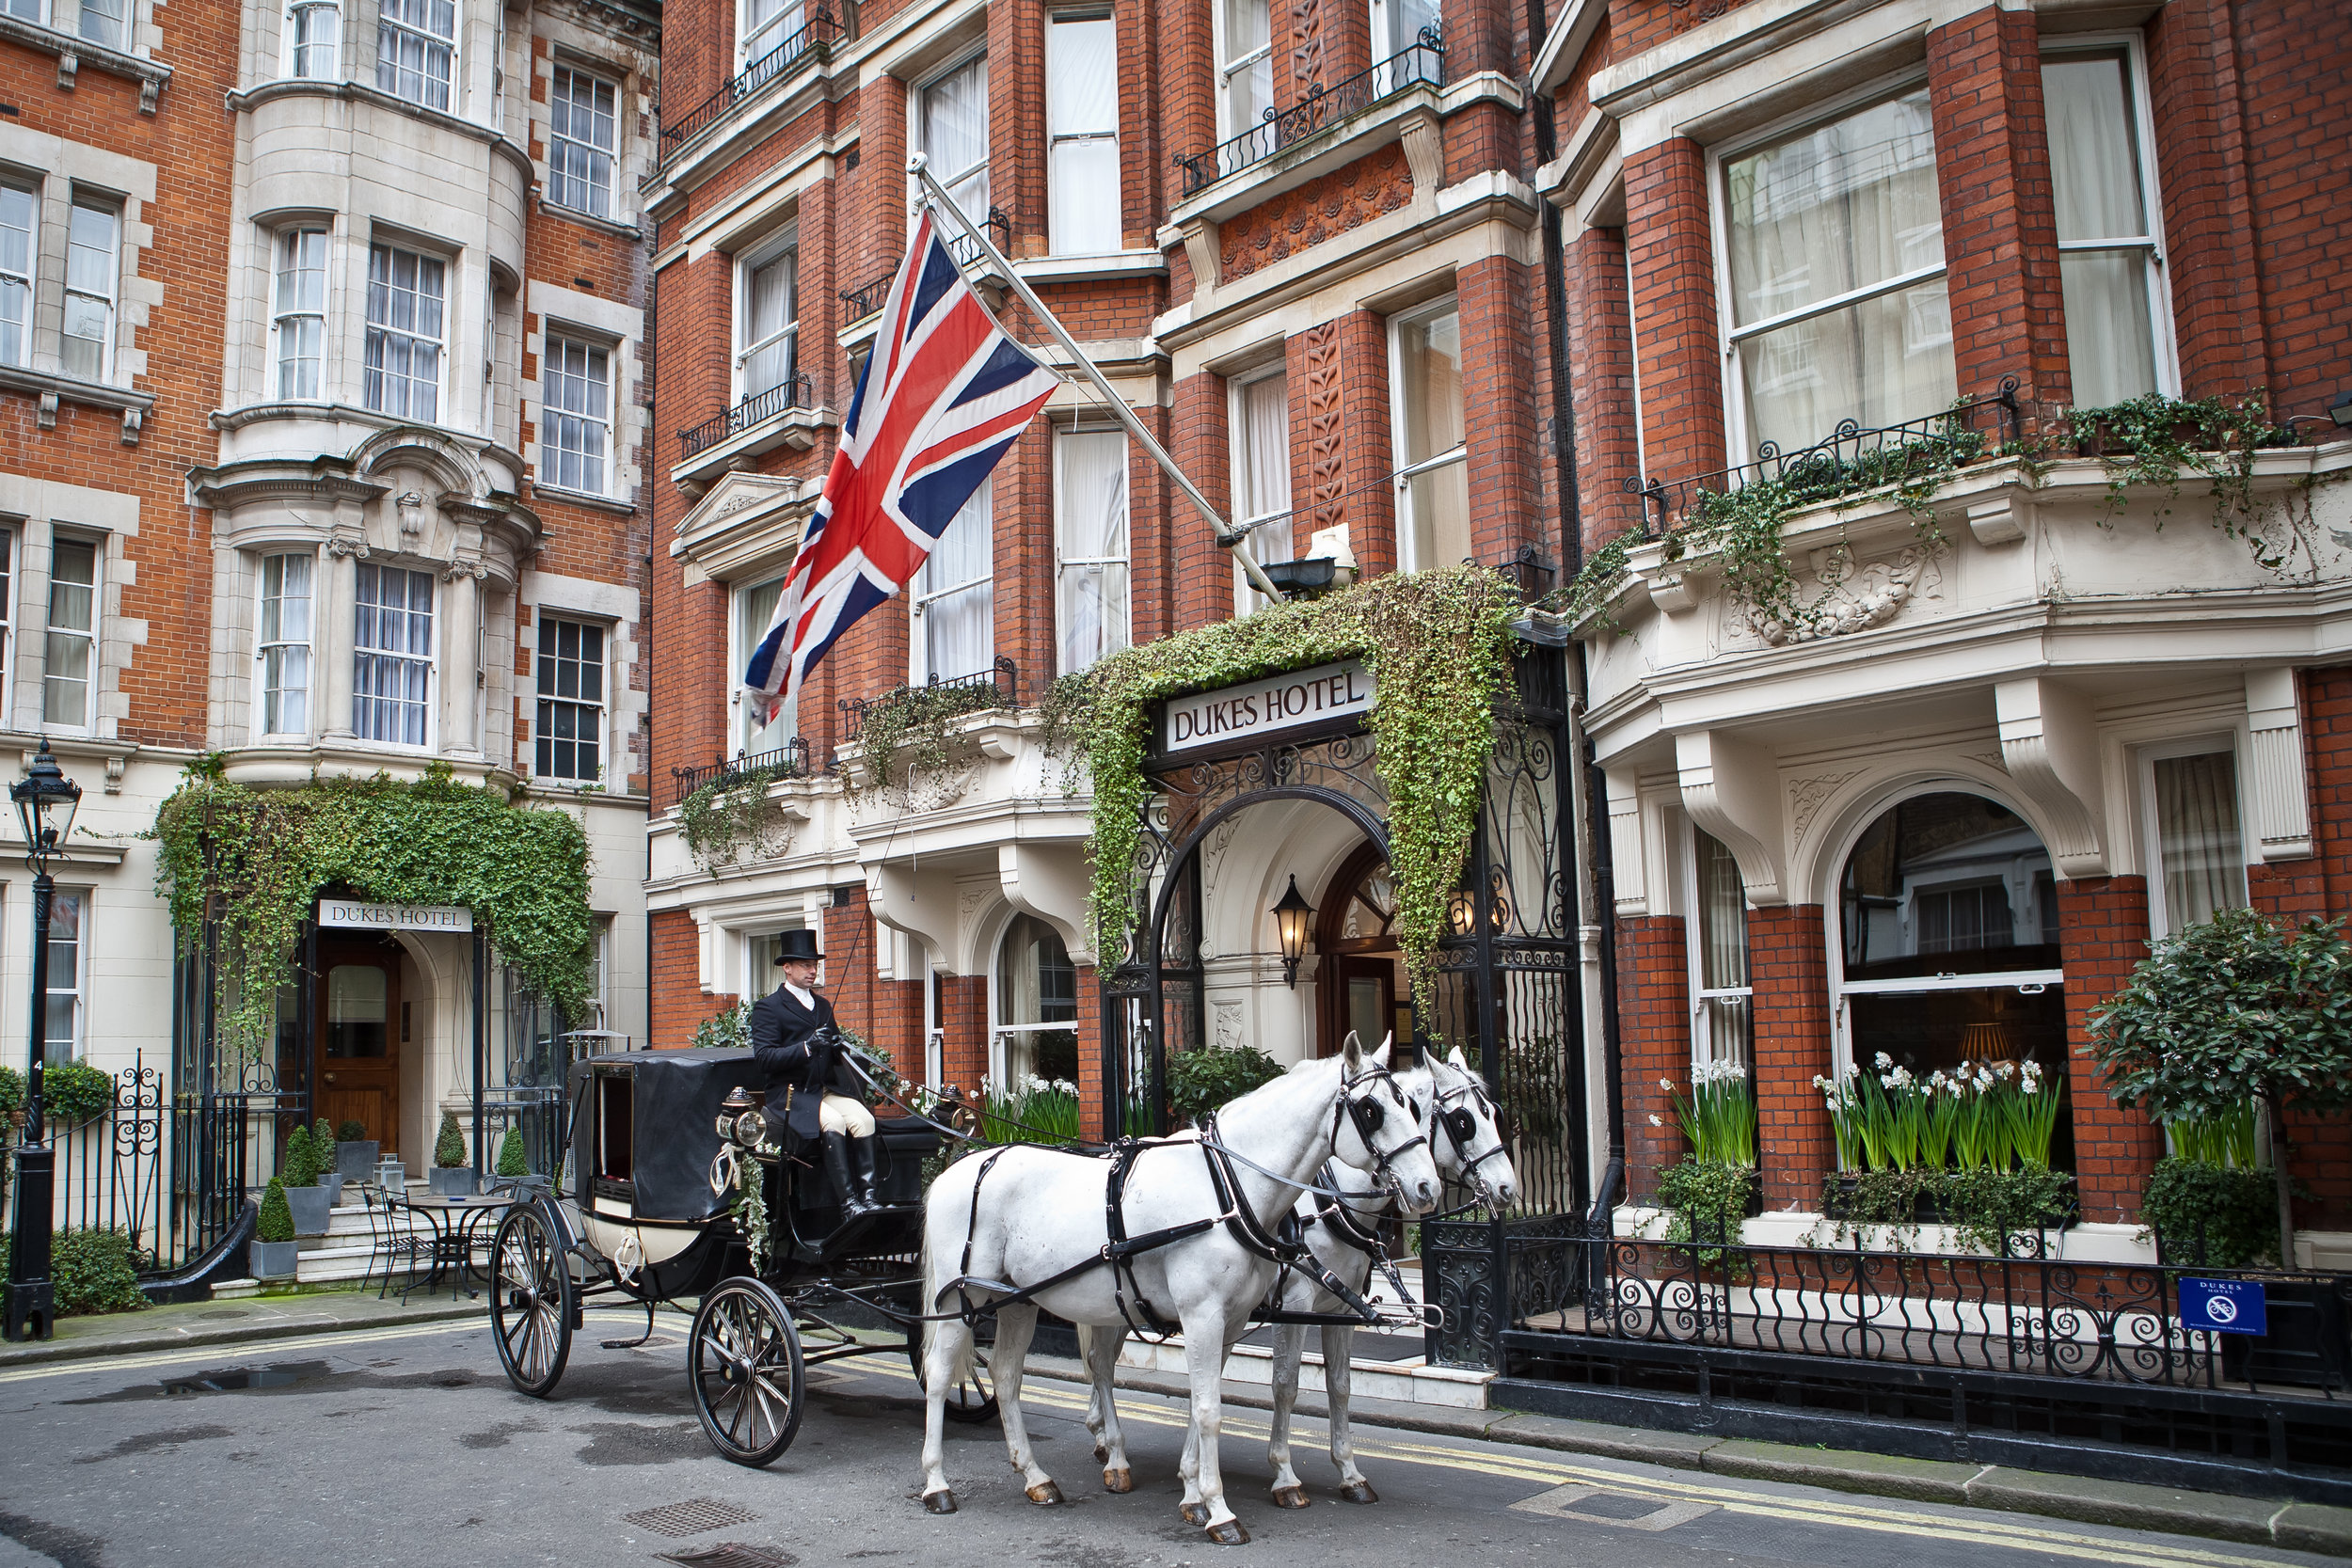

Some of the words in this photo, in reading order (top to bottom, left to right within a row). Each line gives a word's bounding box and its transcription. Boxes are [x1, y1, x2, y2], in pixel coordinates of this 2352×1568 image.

[1174, 695, 1258, 742] DUKES
[1264, 673, 1365, 722] HOTEL
[332, 906, 394, 923] DUKES
[400, 910, 462, 927] HOTEL
[34, 1060, 43, 1070] 4
[2200, 1281, 2242, 1291] DUKES
